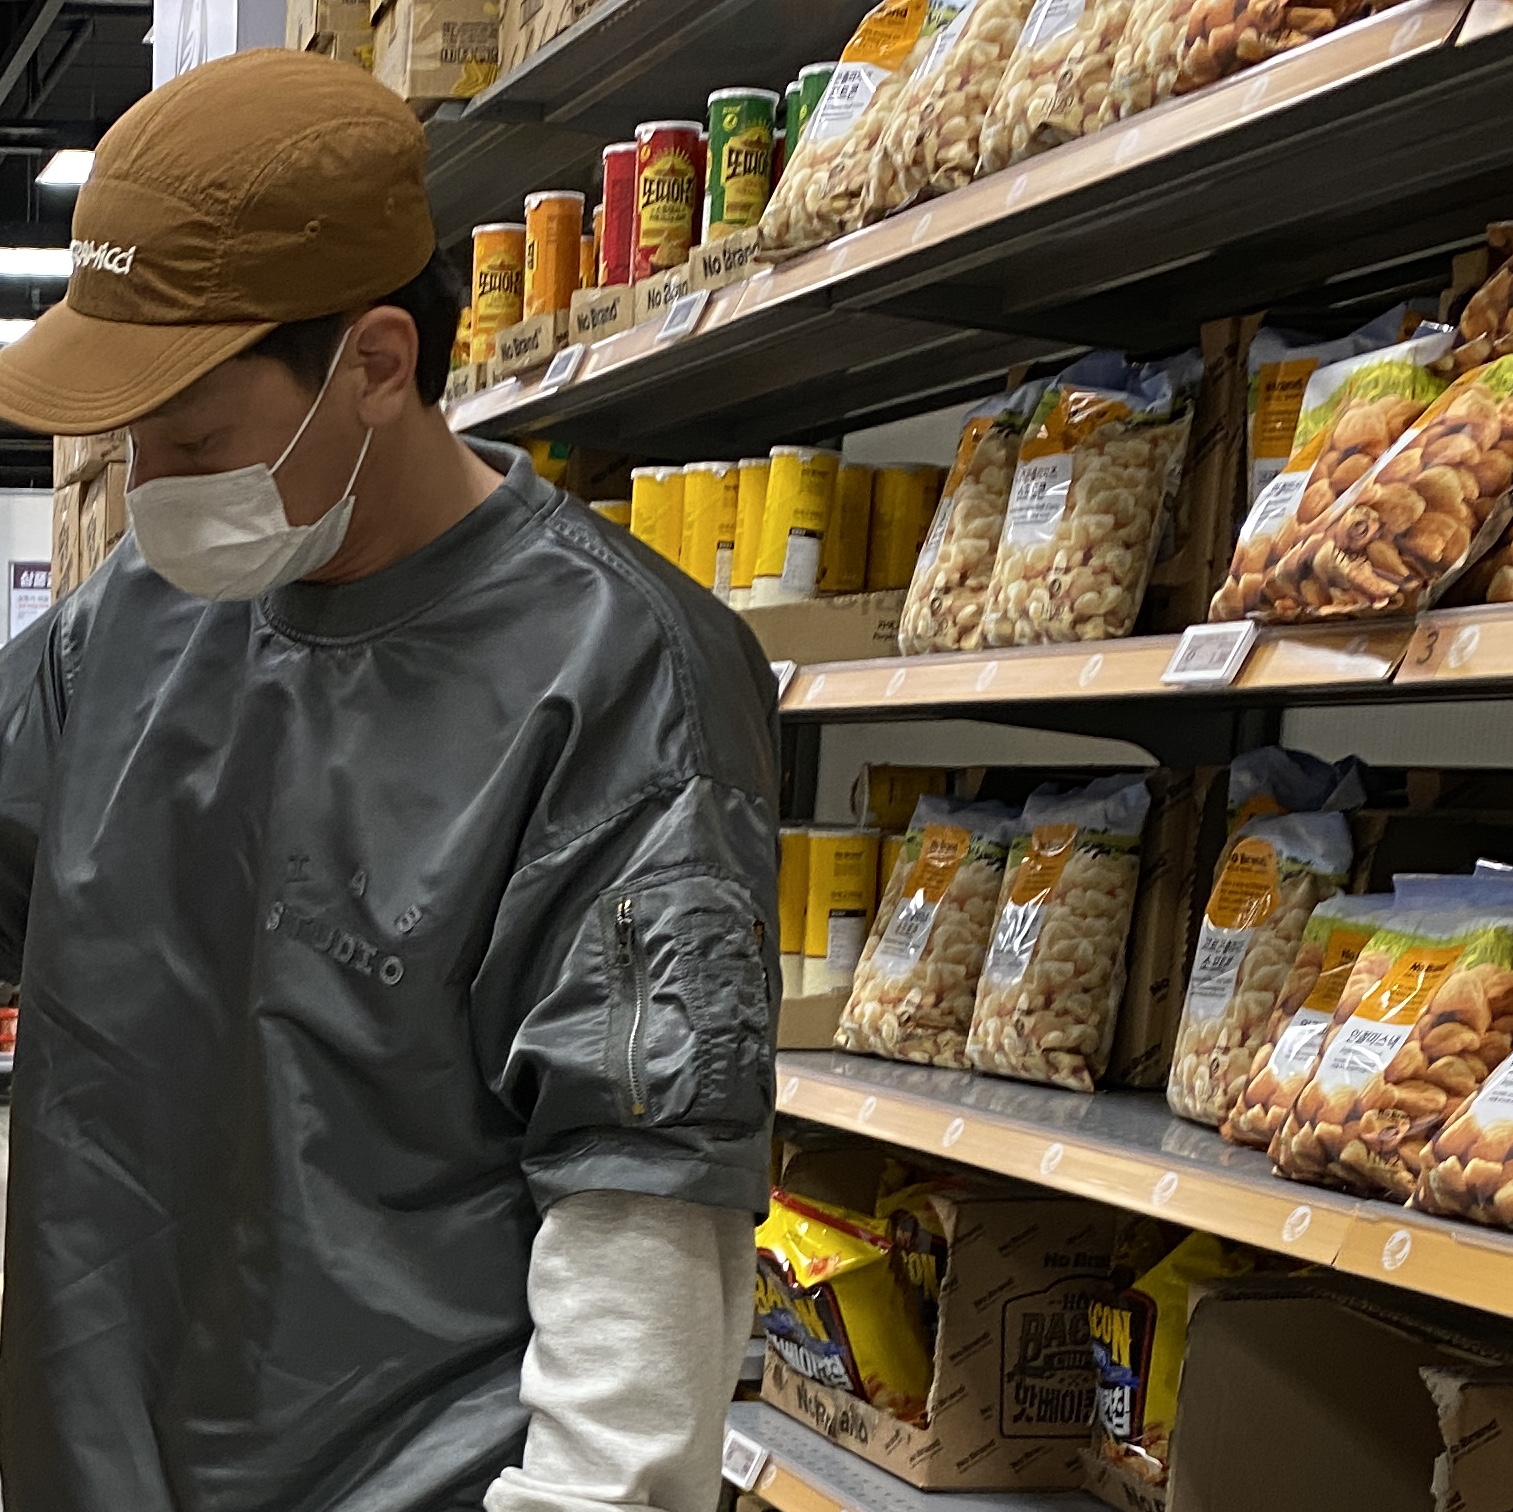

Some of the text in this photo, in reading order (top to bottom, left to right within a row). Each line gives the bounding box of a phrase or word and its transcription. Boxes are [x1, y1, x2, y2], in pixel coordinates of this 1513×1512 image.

[702, 253, 721, 281] No
[648, 288, 662, 310] No
[577, 300, 618, 331] No Brand
[513, 332, 539, 357] Brand
[1020, 1311, 1090, 1350] BAC
